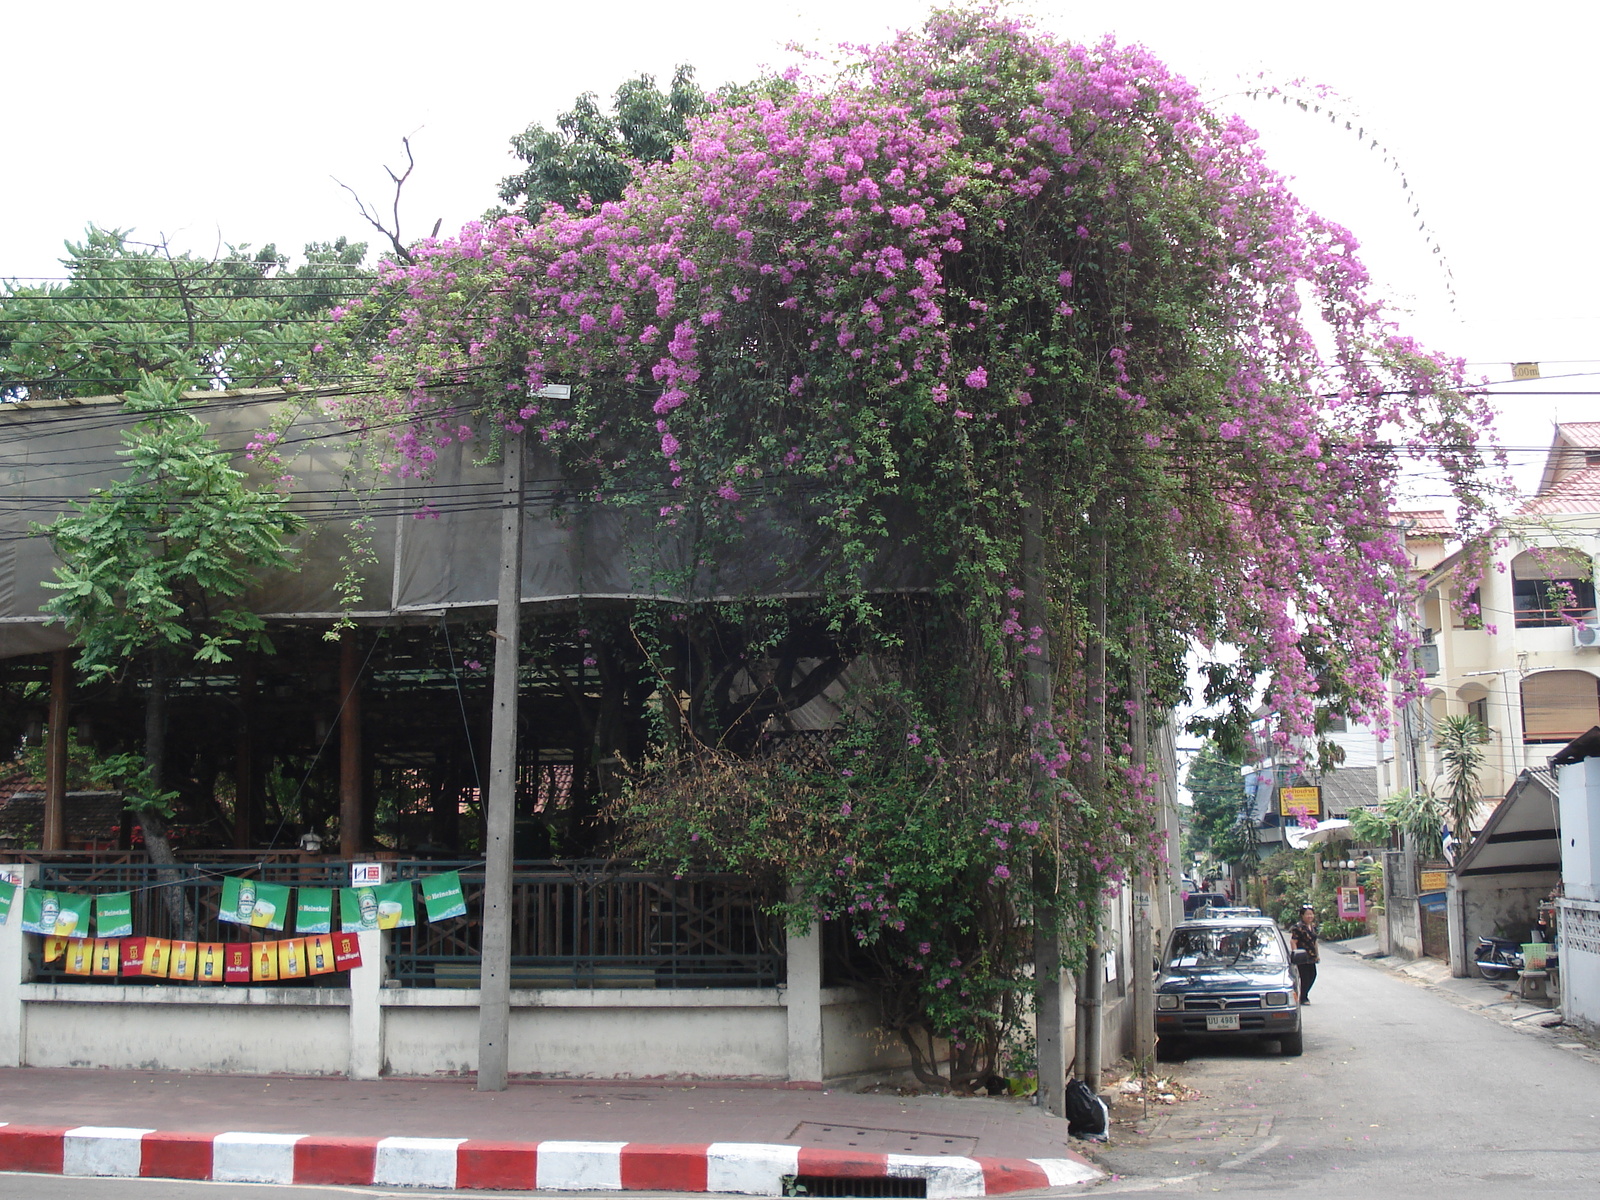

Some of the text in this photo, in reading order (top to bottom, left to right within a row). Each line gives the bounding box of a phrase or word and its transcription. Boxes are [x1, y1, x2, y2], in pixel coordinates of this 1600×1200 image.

[431, 888, 460, 900] Heineken
[104, 908, 130, 917] Heineken
[303, 904, 330, 912] Heineken
